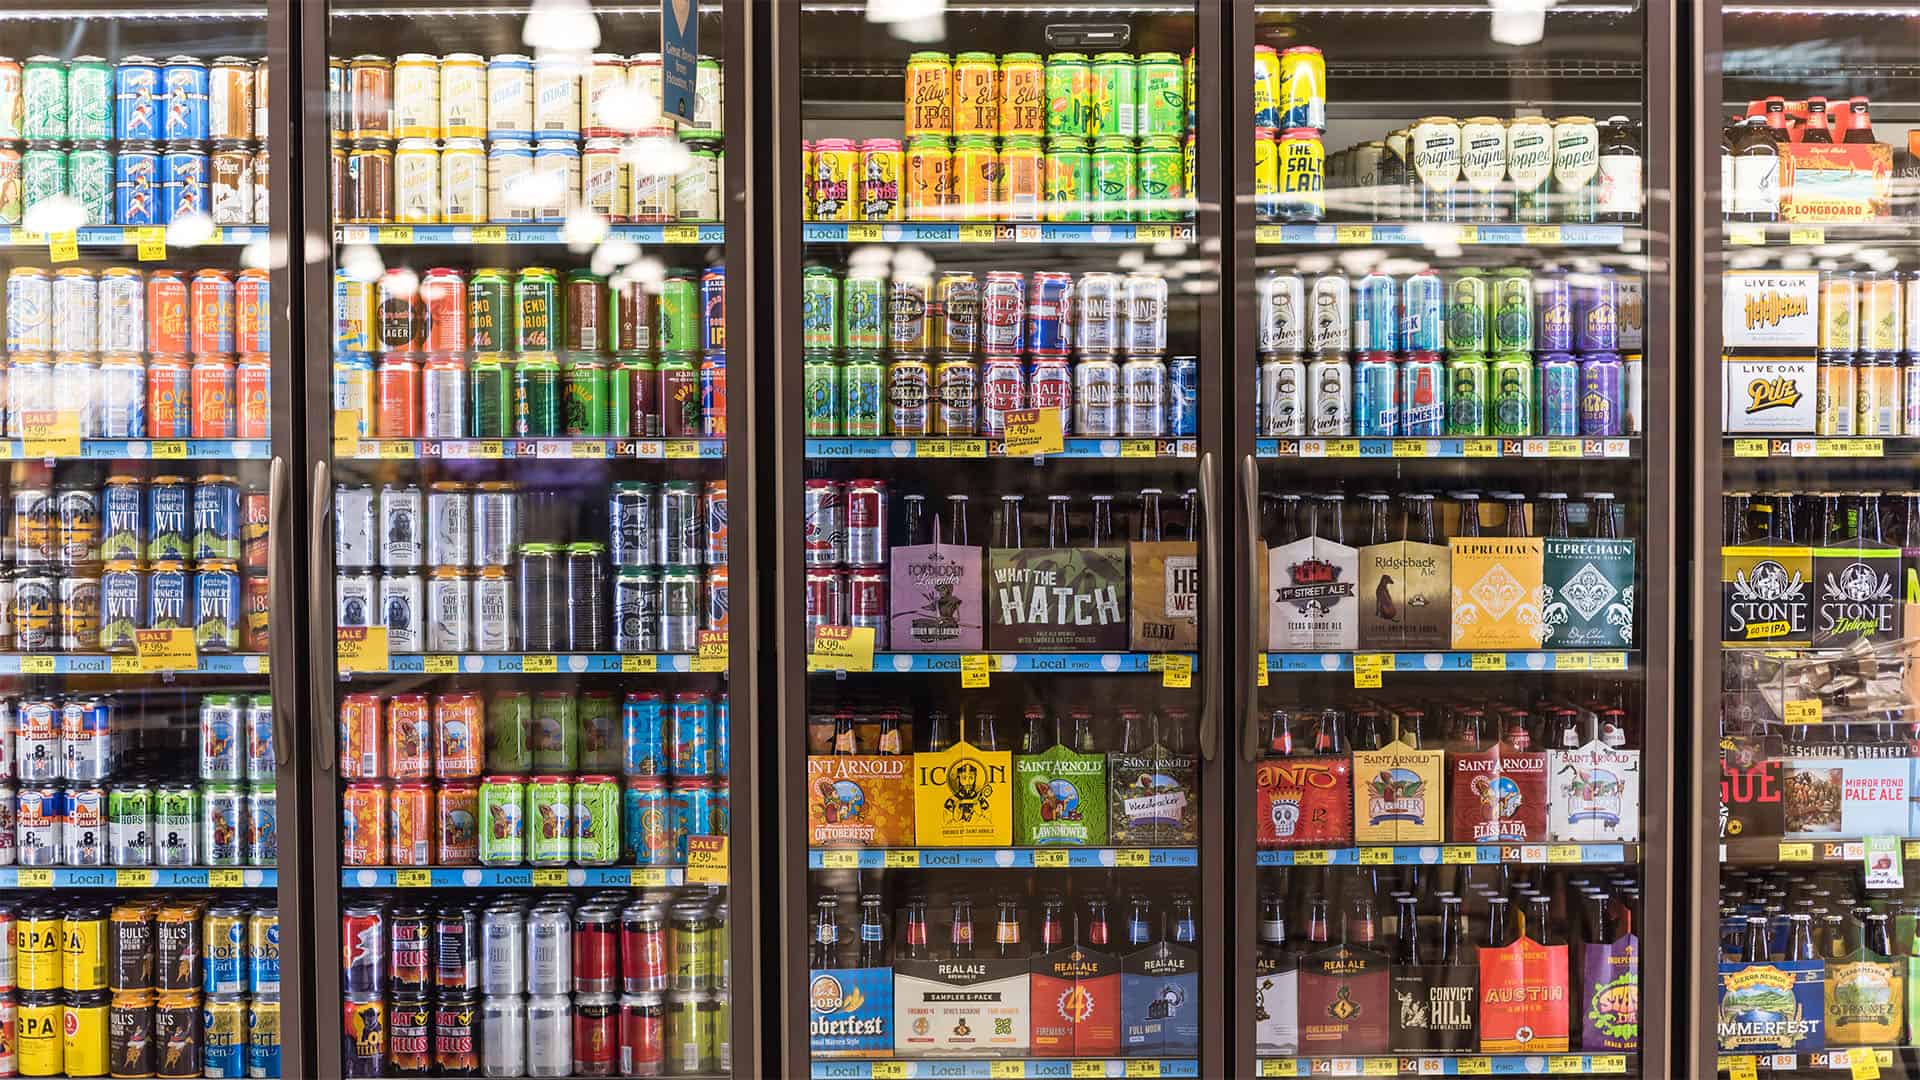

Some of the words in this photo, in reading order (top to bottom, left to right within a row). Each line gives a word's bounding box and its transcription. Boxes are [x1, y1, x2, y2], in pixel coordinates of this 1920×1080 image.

[1288, 144, 1311, 155] THE
[1287, 157, 1322, 172] SALT
[1286, 174, 1323, 192] LAD
[1796, 206, 1862, 216] LONGBOARD
[809, 228, 844, 240] Local
[916, 229, 952, 240] Local
[1007, 413, 1033, 423] SALE
[616, 441, 634, 454] Ba
[641, 443, 657, 453] 85
[818, 443, 852, 454] Local
[1280, 440, 1299, 454] Ba
[1304, 443, 1320, 452] 89
[1360, 442, 1386, 454] ocal
[1504, 441, 1522, 454] Ba
[1528, 443, 1543, 452] 86
[1772, 440, 1790, 452] Ba
[110, 512, 138, 531] WIT
[156, 512, 184, 531] WIT
[1456, 544, 1538, 555] LEPRECHAUN
[1548, 543, 1632, 555] LEPRECHAUN
[1376, 556, 1436, 570] Ridgeback
[994, 568, 1031, 584] WHAT
[1032, 570, 1057, 586] THE
[1294, 586, 1327, 598] STREET
[1328, 585, 1345, 595] ALE
[108, 598, 136, 618] WIT
[154, 598, 182, 618] WIT
[202, 598, 230, 618] WIT
[1000, 586, 1121, 626] HATCH
[1174, 595, 1194, 610] WE
[1730, 602, 1808, 632] STONE
[1820, 604, 1895, 632] STONE
[820, 627, 848, 638] SALE
[1770, 623, 1786, 633] IPA
[704, 632, 728, 642] SALE
[70, 659, 105, 670] Local
[392, 659, 422, 671] Loca
[927, 658, 961, 670] Local
[1032, 658, 1066, 670] Local
[1802, 708, 1816, 716] 8.99
[34, 744, 45, 759] 8
[1856, 745, 1908, 758] BREWERY
[1123, 758, 1150, 768] SAINT
[1151, 758, 1190, 769] ARNOLD
[1364, 755, 1390, 764] SAINT
[1390, 754, 1430, 766] ARNOLD
[1562, 752, 1589, 763] SAINT
[1590, 751, 1629, 765] ARNOLD
[834, 758, 904, 779] ARNOLD
[1017, 760, 1052, 772] SAINT
[1052, 759, 1102, 775] ARNOLD
[1458, 759, 1494, 772] SAINT
[1494, 758, 1544, 774] ARNOLD
[1845, 778, 1878, 786] MIRROR
[1880, 778, 1904, 786] POND
[1845, 788, 1876, 801] PALE
[1880, 788, 1904, 801] ALE
[815, 828, 875, 841] OKTOBERFEST
[1510, 823, 1527, 836] IPA
[83, 831, 94, 846] 8
[690, 840, 718, 848] SALE
[1501, 846, 1520, 860] Ba
[1526, 848, 1542, 858] 86
[1825, 844, 1842, 856] Ba
[925, 854, 960, 866] Local
[70, 874, 104, 884] Local
[174, 873, 208, 884] Local
[496, 872, 531, 884] Local
[600, 872, 631, 884] Loca
[120, 927, 150, 939] BULL'S
[938, 964, 966, 974] REAL
[966, 964, 986, 974] ALE
[1054, 962, 1078, 972] REAL
[1080, 962, 1099, 972] ALE
[1144, 960, 1168, 970] REAL
[1168, 959, 1185, 969] ALE
[1258, 960, 1276, 969] ALE
[1324, 961, 1346, 970] REAL
[1348, 960, 1366, 969] ALE
[1734, 974, 1758, 984] SIERRA
[1758, 974, 1786, 984] NEVADA
[1430, 987, 1474, 1001] CONVICT
[1485, 986, 1563, 1004] AUSTIN
[1066, 985, 1085, 1024] 4
[1431, 1001, 1472, 1024] HILL
[1129, 1025, 1144, 1035] FULL
[1145, 1024, 1162, 1034] MOON
[1718, 1020, 1819, 1035] MMERFEST
[1400, 1058, 1418, 1072] Ba
[1424, 1060, 1439, 1070] 86
[1776, 1056, 1792, 1065] 89
[1811, 1054, 1828, 1066] Ba
[825, 1066, 860, 1078] Local
[931, 1065, 966, 1077] Local
[1035, 1064, 1070, 1076] Local
